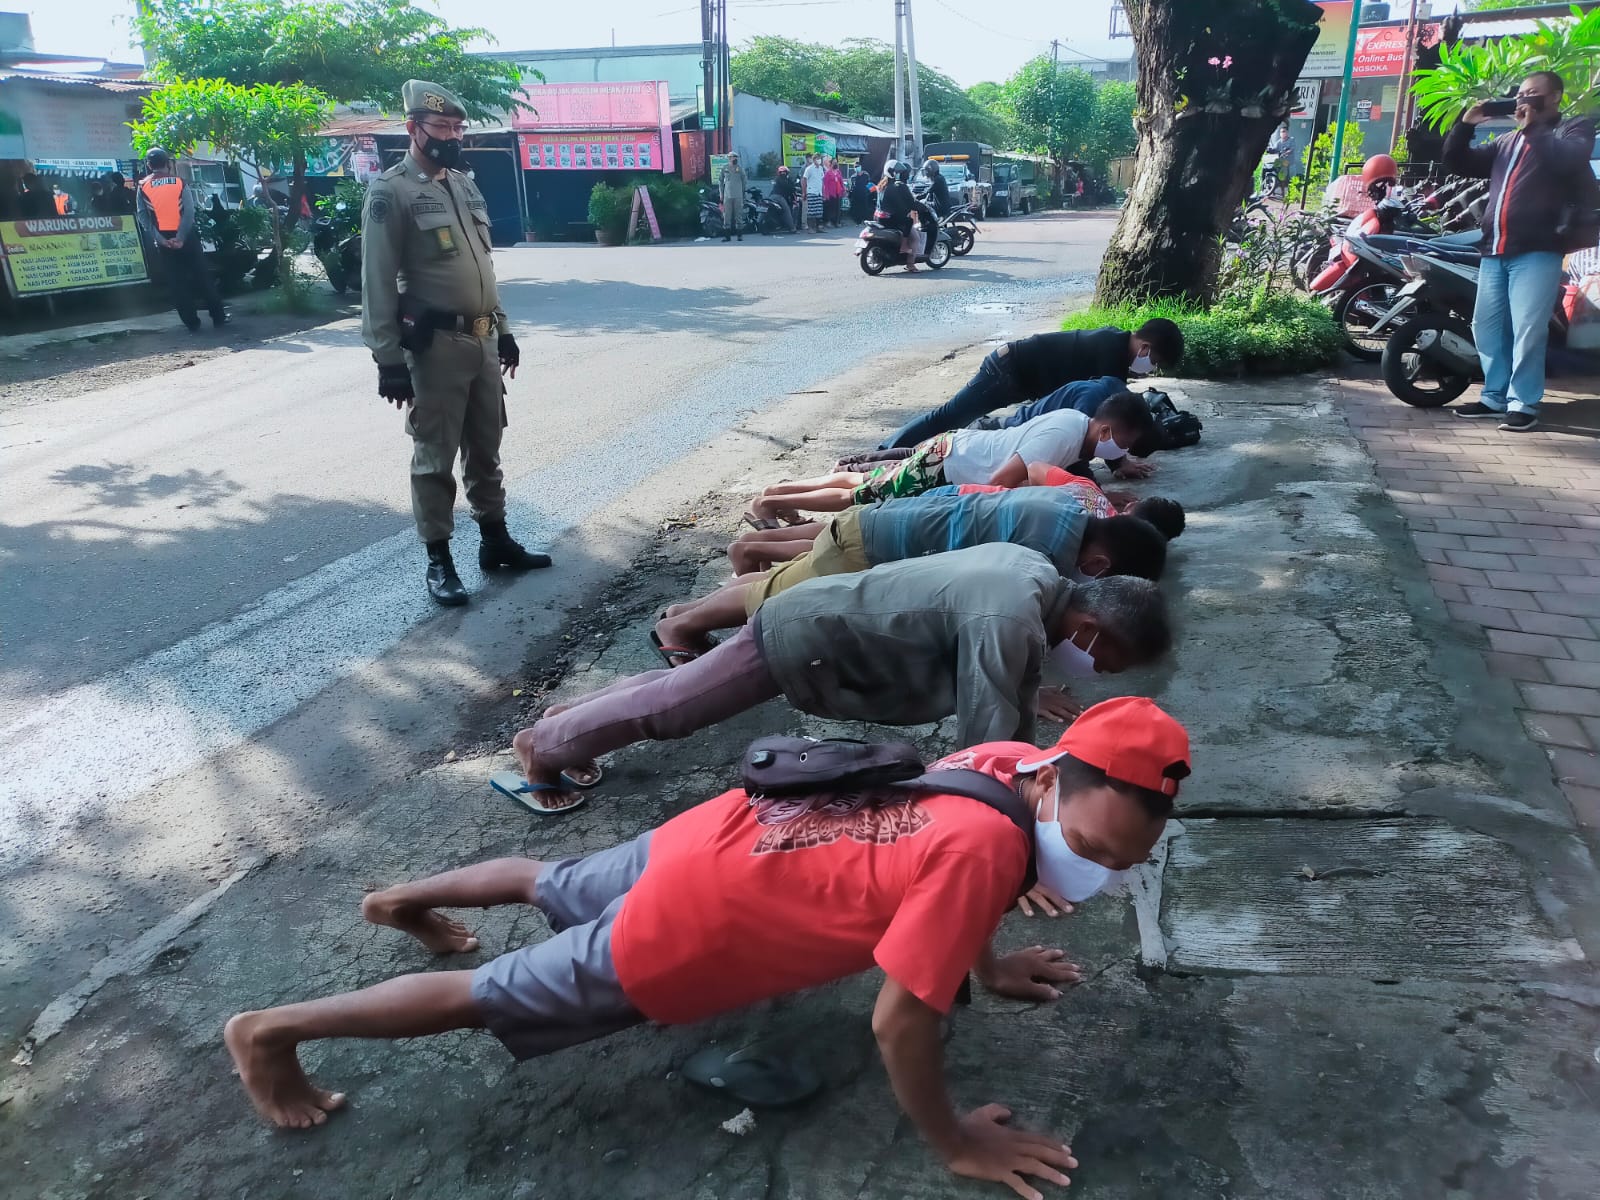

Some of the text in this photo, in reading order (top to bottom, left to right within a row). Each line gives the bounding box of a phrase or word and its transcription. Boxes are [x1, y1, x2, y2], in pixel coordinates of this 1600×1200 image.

[1358, 54, 1385, 62] Online
[25, 217, 114, 232] WARUNG POJOK
